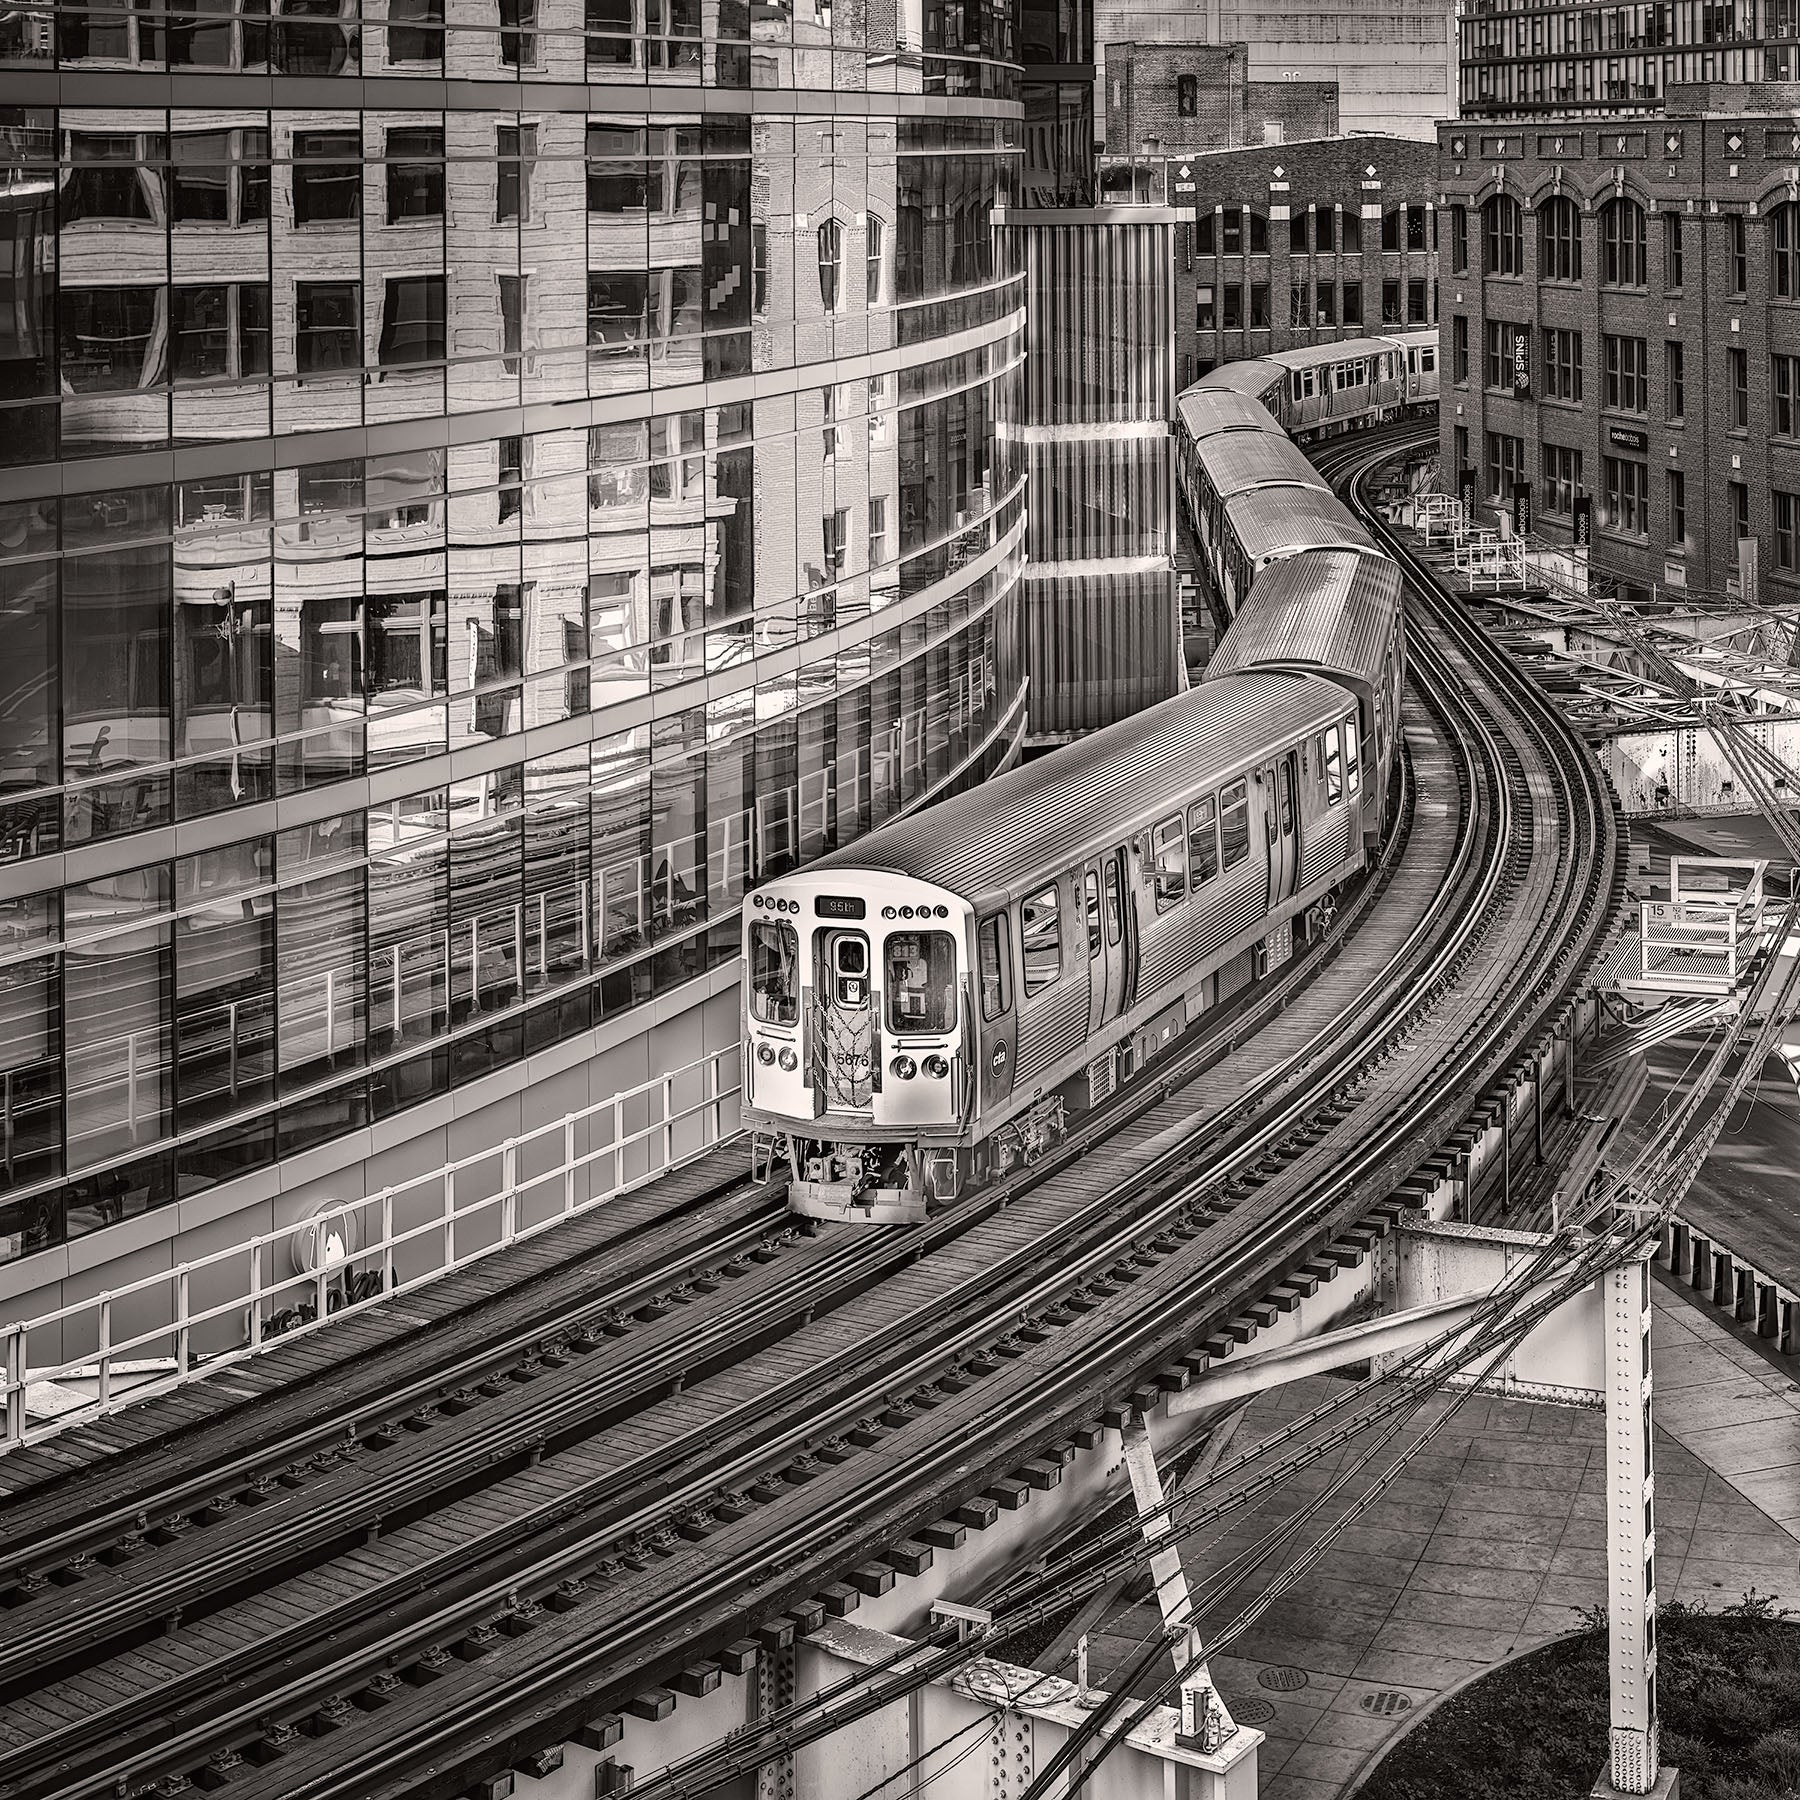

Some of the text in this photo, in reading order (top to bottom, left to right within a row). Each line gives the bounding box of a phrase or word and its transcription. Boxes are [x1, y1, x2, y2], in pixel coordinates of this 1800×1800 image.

[1515, 335, 1525, 371] SPINS
[830, 900, 855, 913] 95th
[1651, 905, 1664, 916] 15
[893, 945, 918, 957] 813
[837, 1053, 869, 1067] 5676
[992, 1051, 1006, 1067] cta
